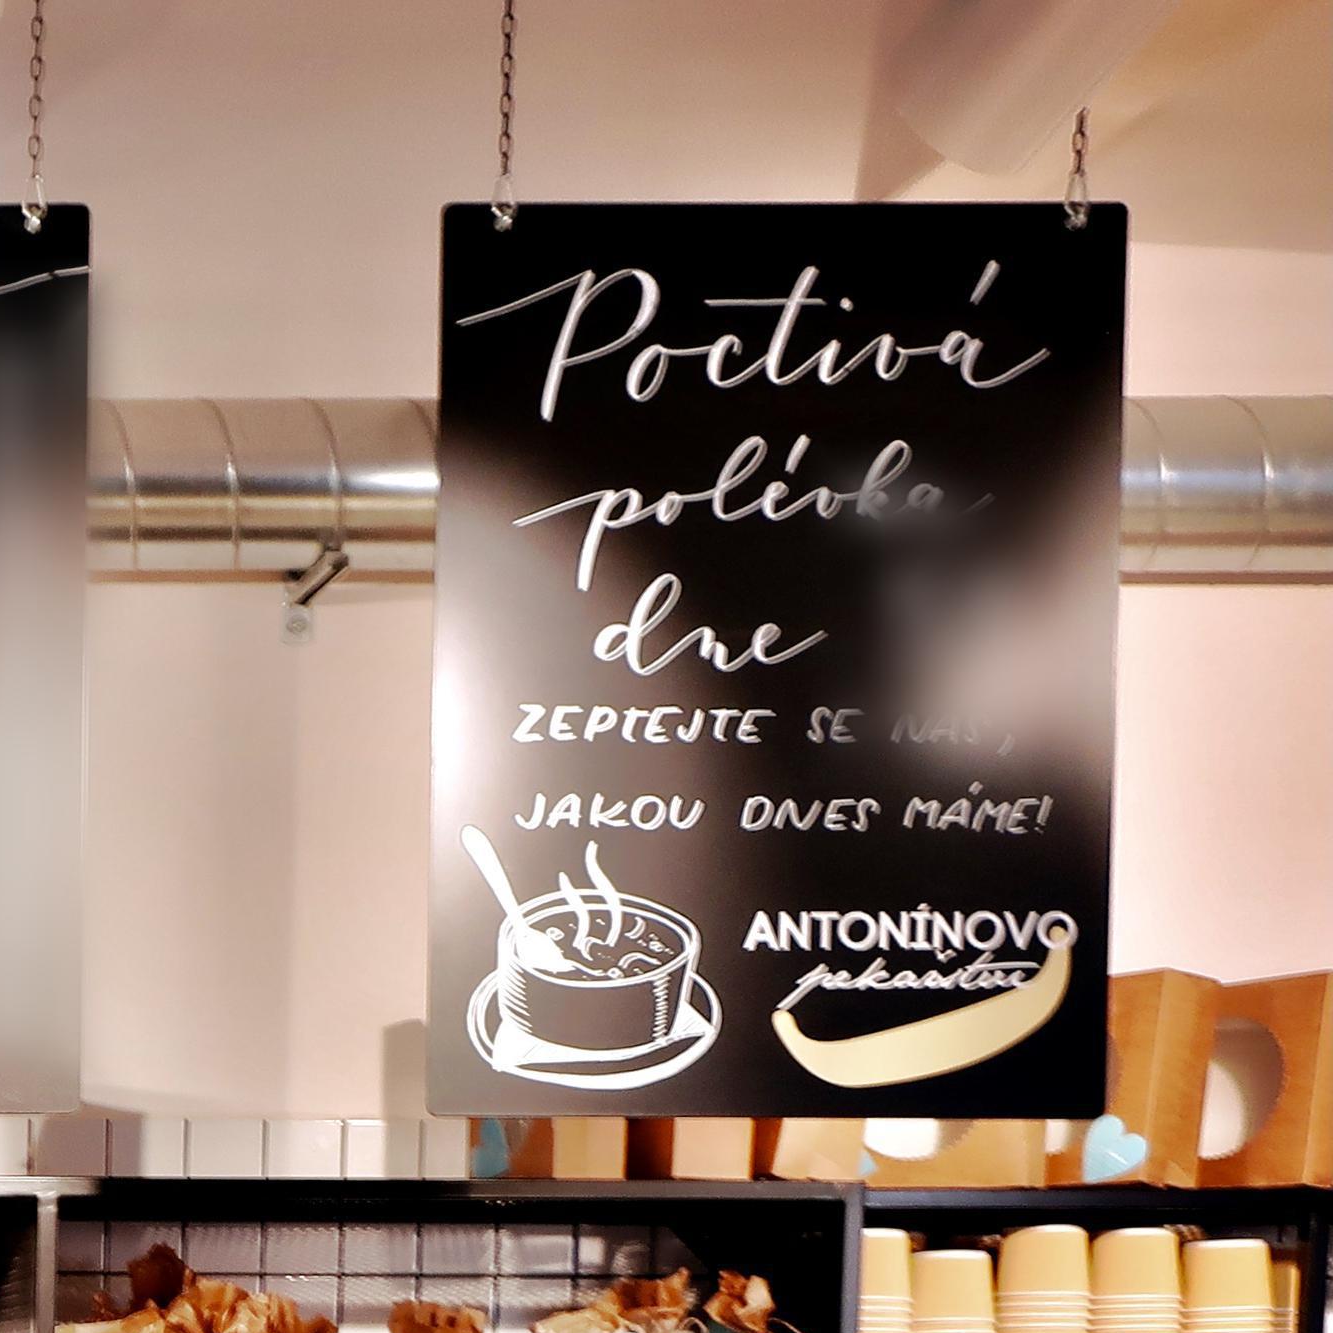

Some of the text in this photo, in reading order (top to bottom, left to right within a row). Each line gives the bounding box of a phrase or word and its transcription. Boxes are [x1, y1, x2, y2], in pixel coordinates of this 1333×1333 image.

[456, 259, 1050, 423] Poctivá
[512, 434, 995, 592] polévka
[594, 572, 828, 677] dne
[511, 703, 776, 744] ZEPTEJTE
[805, 706, 865, 743] SE
[514, 781, 1054, 836] JAKOU DNES MÁME!
[742, 902, 1079, 951] ANTONÍNOVO
